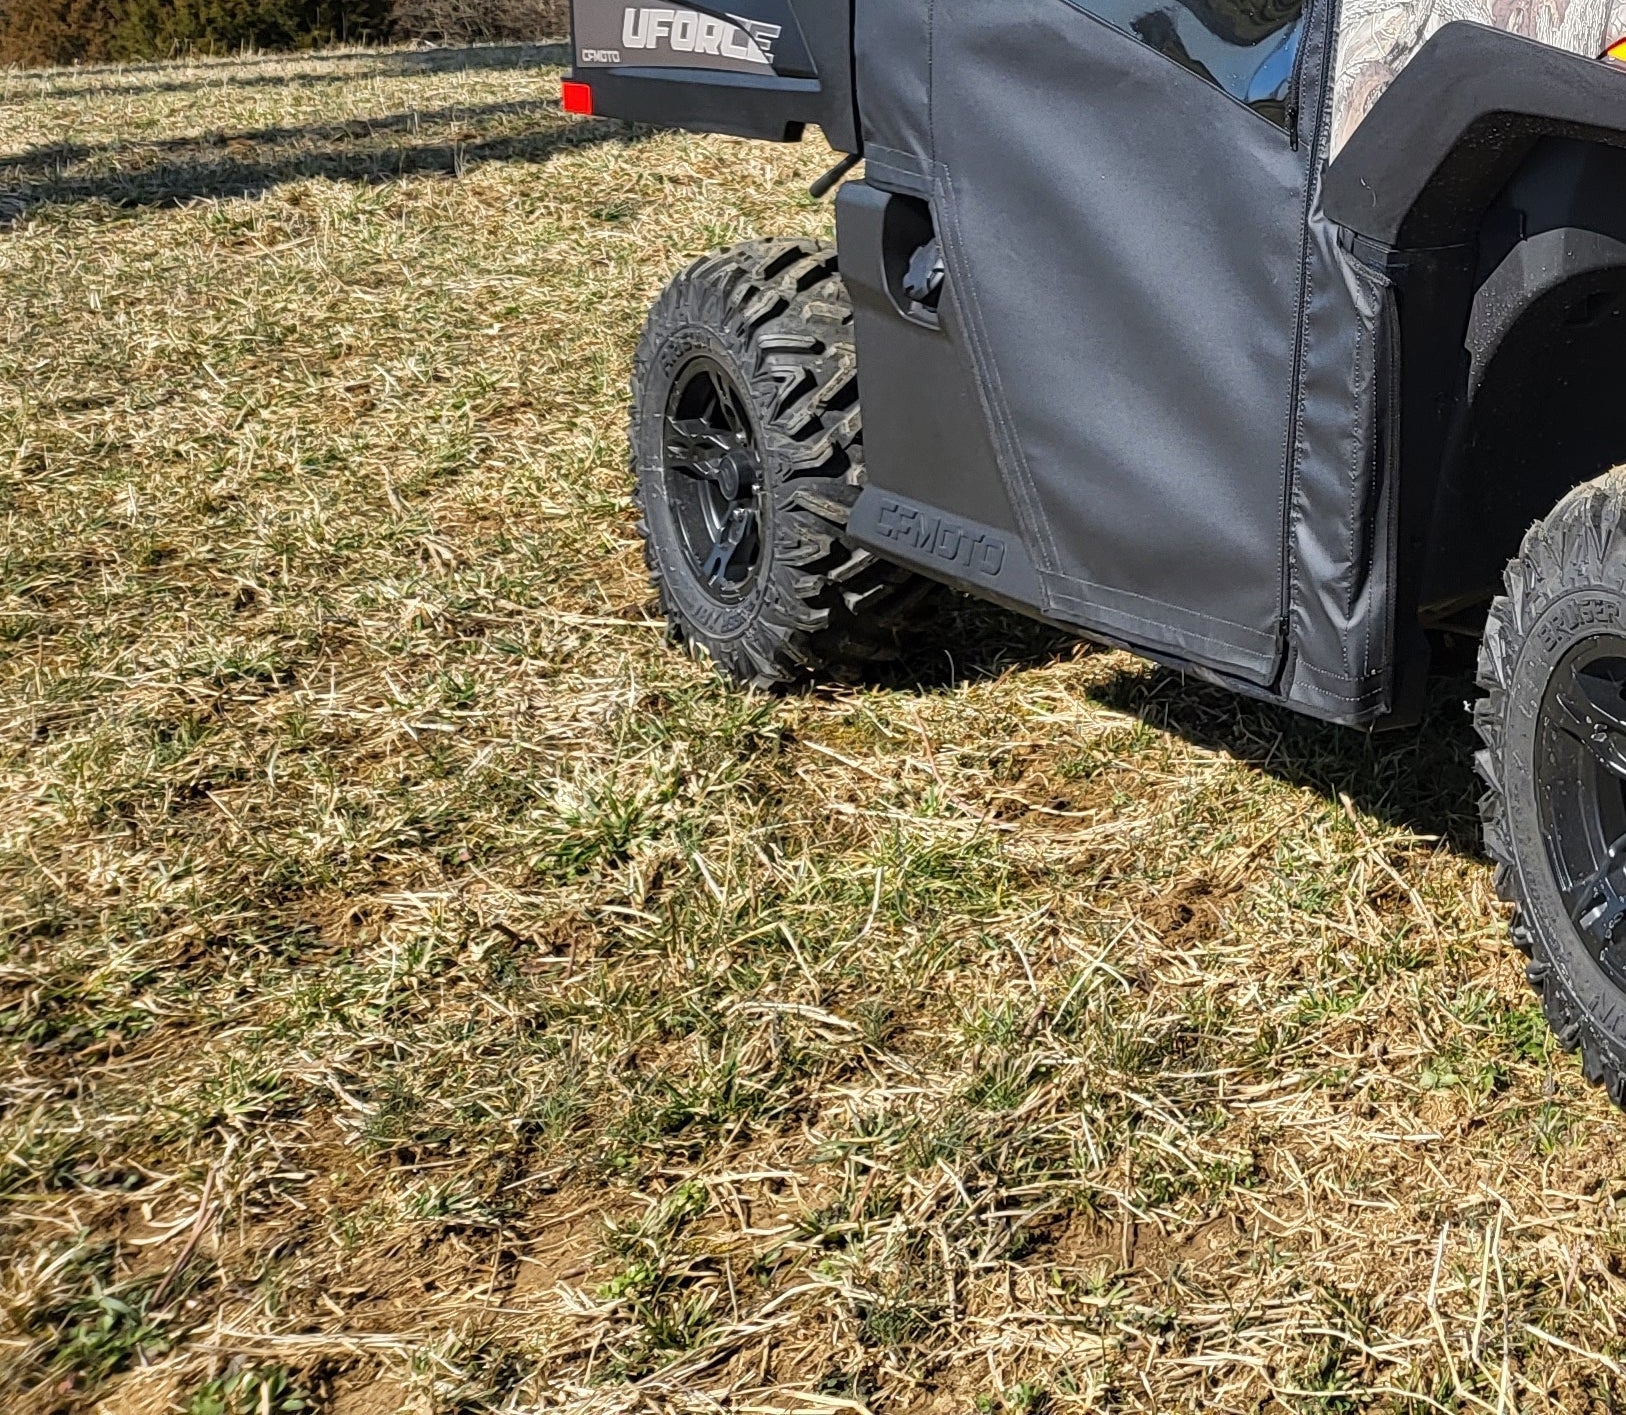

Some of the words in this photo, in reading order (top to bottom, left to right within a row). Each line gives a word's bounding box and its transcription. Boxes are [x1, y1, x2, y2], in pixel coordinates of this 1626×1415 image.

[581, 48, 621, 63] CFMOTO
[622, 7, 782, 64] UFORCE
[876, 498, 1006, 576] CFMOTO
